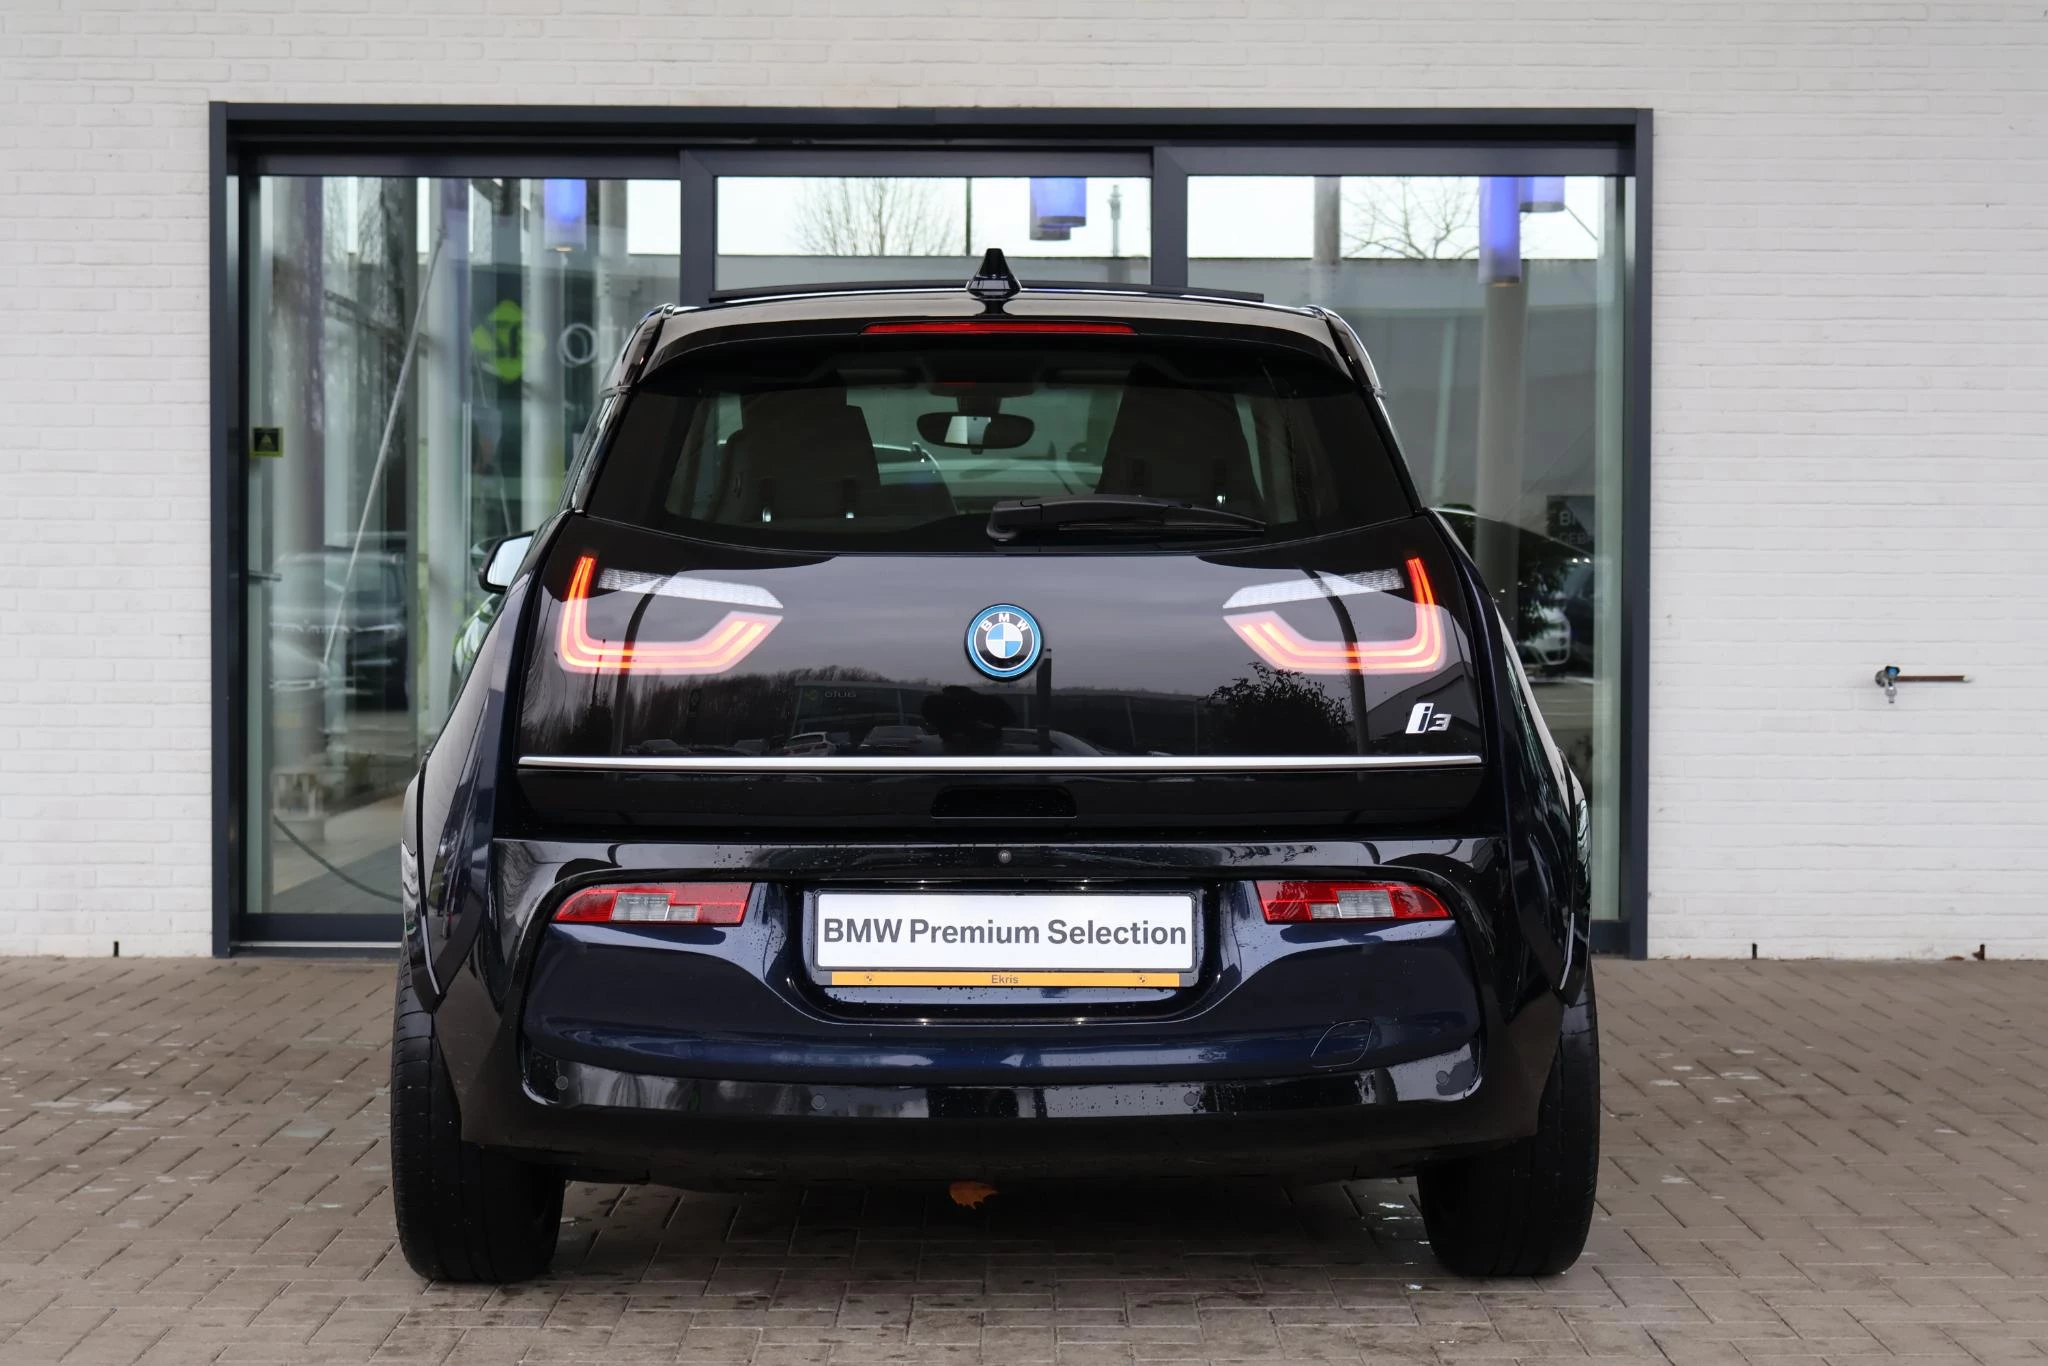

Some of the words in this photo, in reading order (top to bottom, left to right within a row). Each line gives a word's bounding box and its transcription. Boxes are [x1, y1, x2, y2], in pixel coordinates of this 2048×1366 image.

[980, 613, 1029, 632] BMW
[1405, 702, 1452, 734] i3
[824, 918, 902, 943] BMW
[910, 918, 1040, 944] Premium
[1047, 919, 1186, 945] Selection
[991, 974, 1019, 985] Ekris
